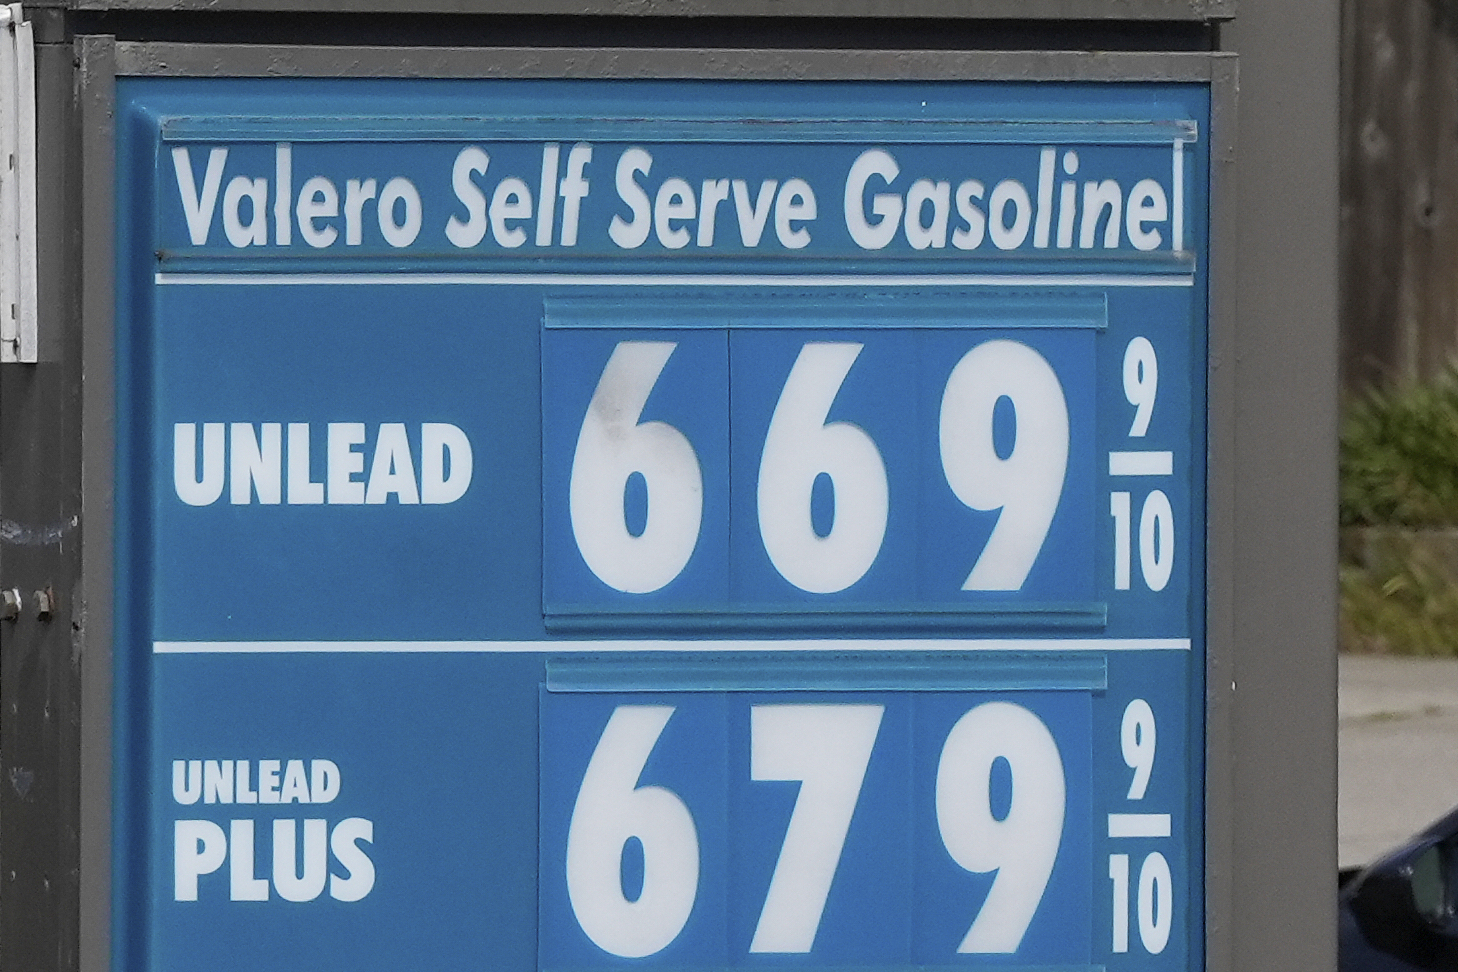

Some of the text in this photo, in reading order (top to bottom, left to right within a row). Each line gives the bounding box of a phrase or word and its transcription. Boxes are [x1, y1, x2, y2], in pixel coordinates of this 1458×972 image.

[172, 142, 1168, 251] Valero Self Serve Gasoline
[174, 422, 473, 506] UNLEAD
[569, 340, 1069, 594] 669
[172, 759, 341, 805] UNLEAD
[566, 702, 1066, 958] 679
[174, 817, 375, 902] PLUS
